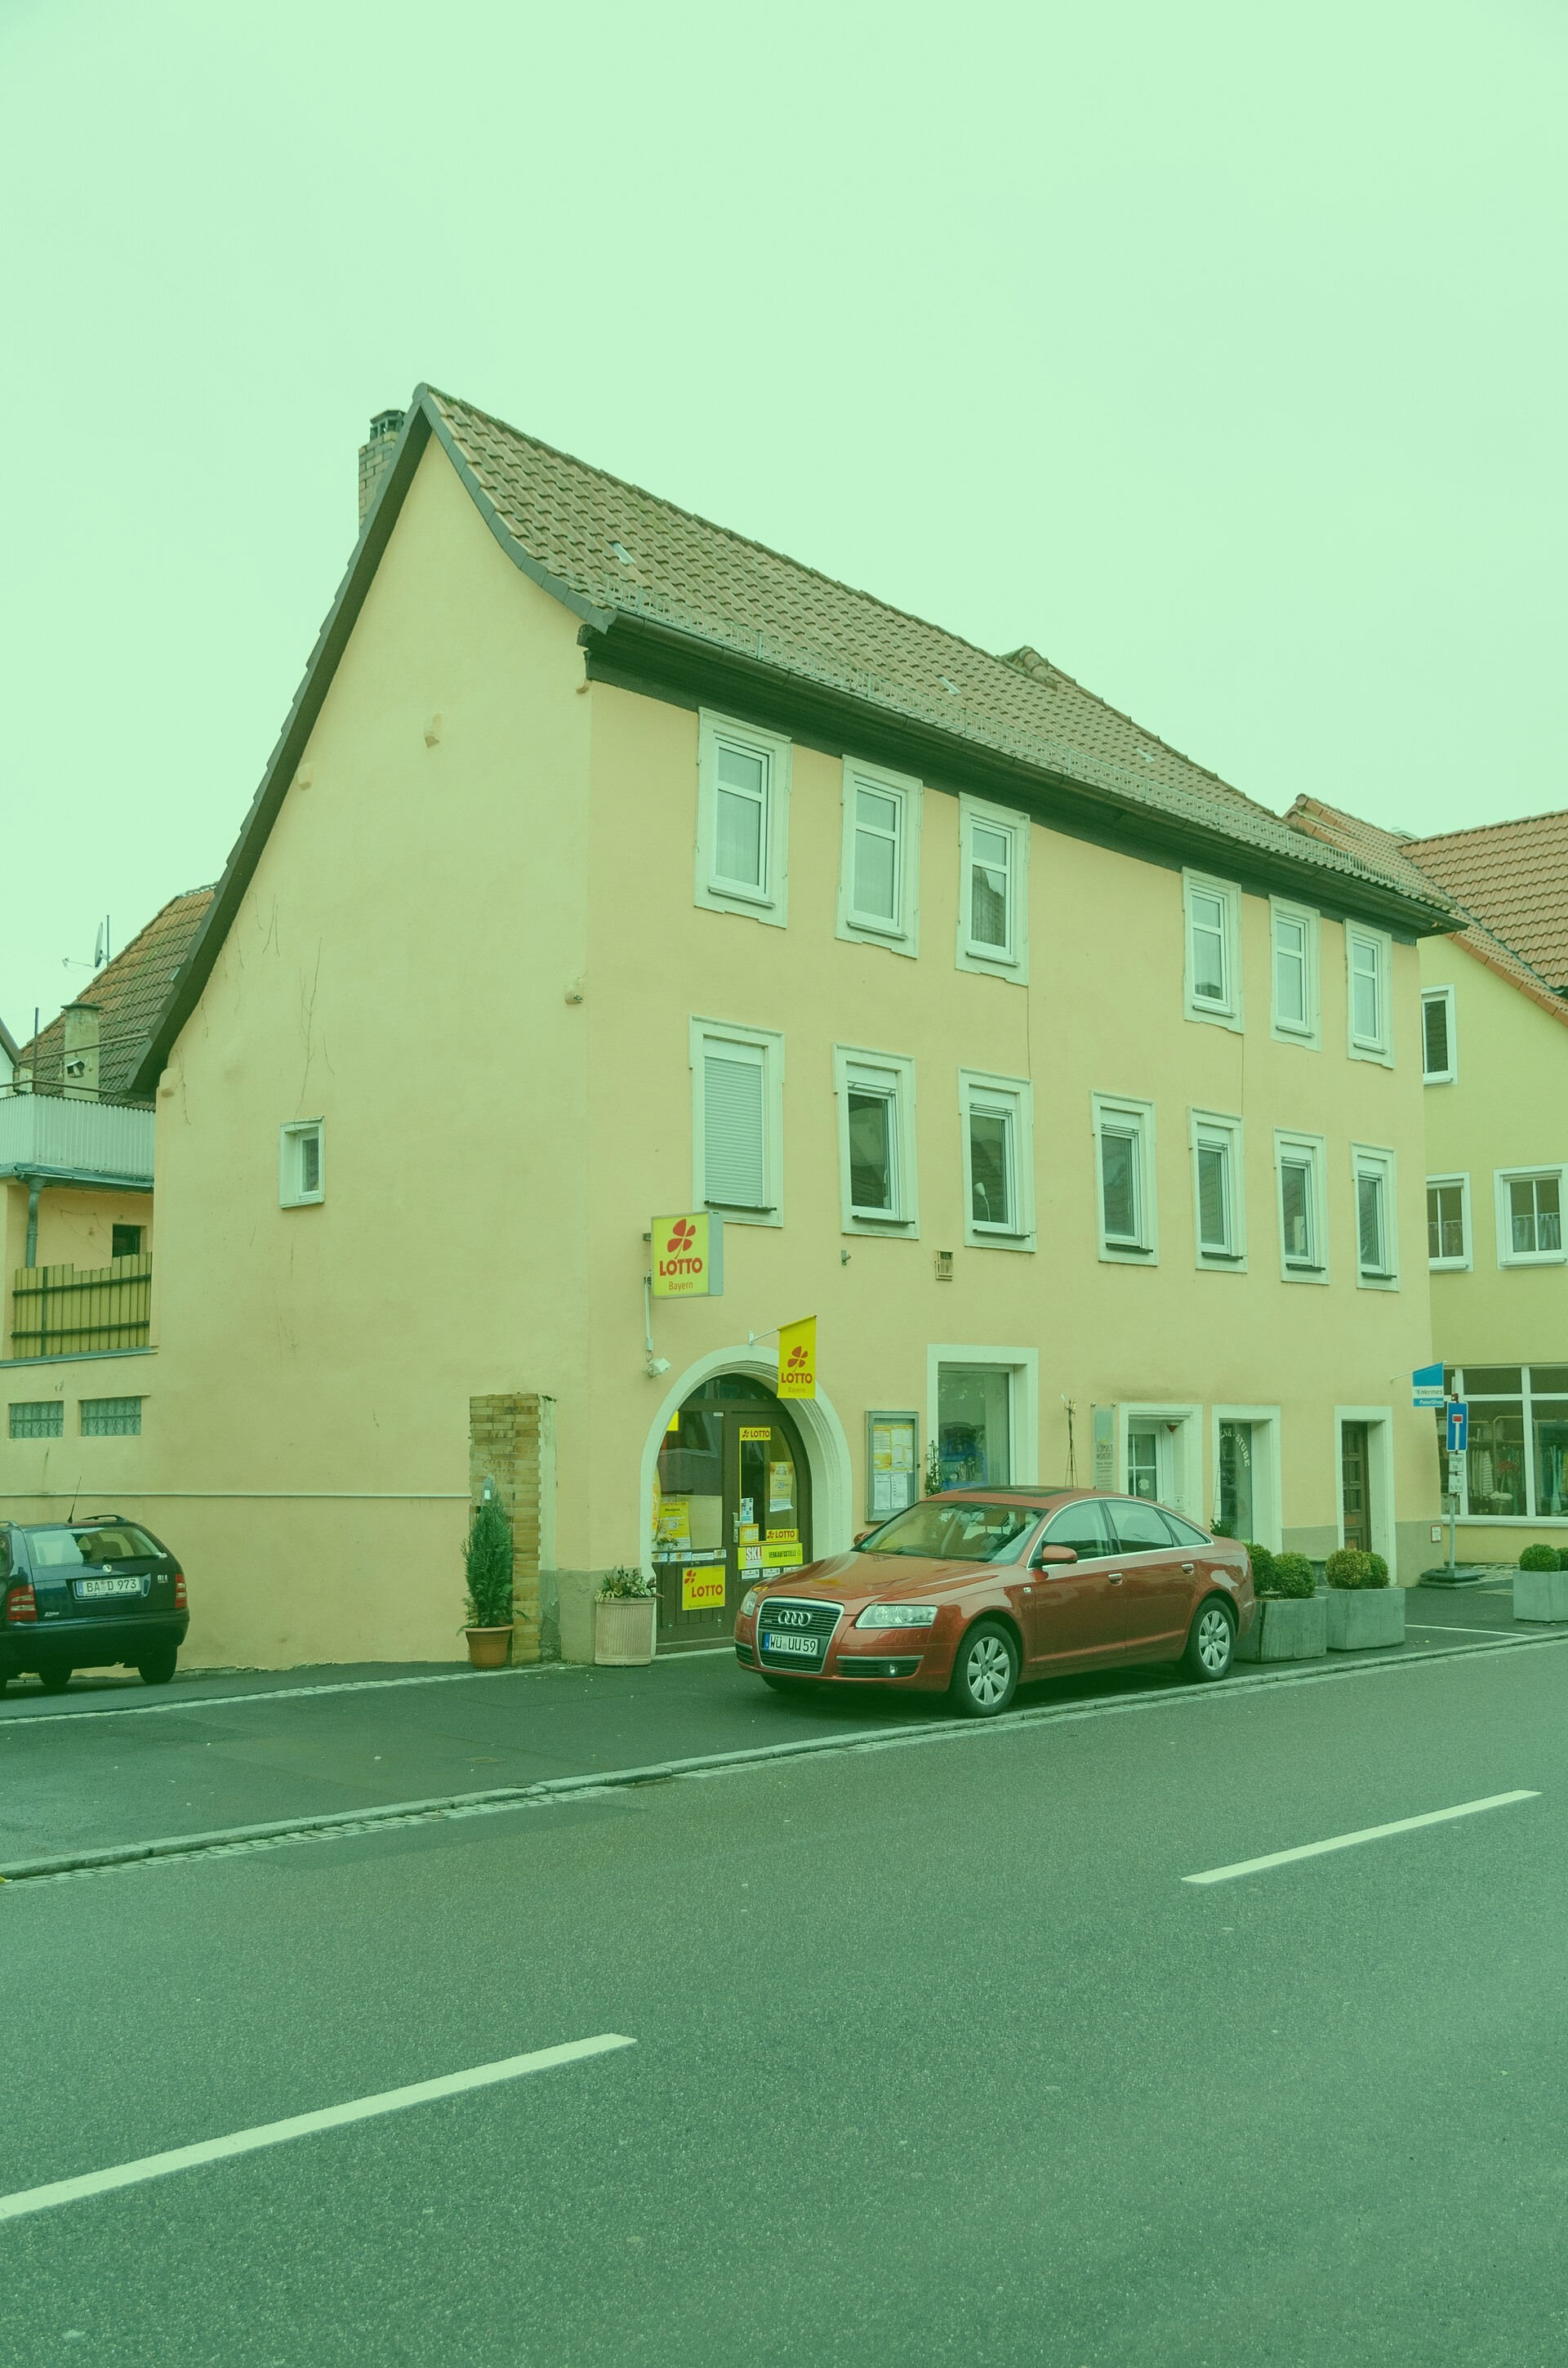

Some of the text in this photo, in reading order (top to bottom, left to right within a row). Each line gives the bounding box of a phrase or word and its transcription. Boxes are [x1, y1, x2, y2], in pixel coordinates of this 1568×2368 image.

[659, 1257, 702, 1276] LOTTO
[669, 1281, 693, 1292] Bayern
[781, 1372, 813, 1384] LOTTO
[750, 1429, 770, 1438] LOTTO
[775, 1530, 795, 1538] LOTTO
[746, 1546, 761, 1560] SKL
[87, 1582, 100, 1593] BA
[107, 1581, 114, 1590] D
[118, 1579, 136, 1590] 973
[691, 1584, 724, 1598] LOTTO
[770, 1635, 782, 1648] WÜ
